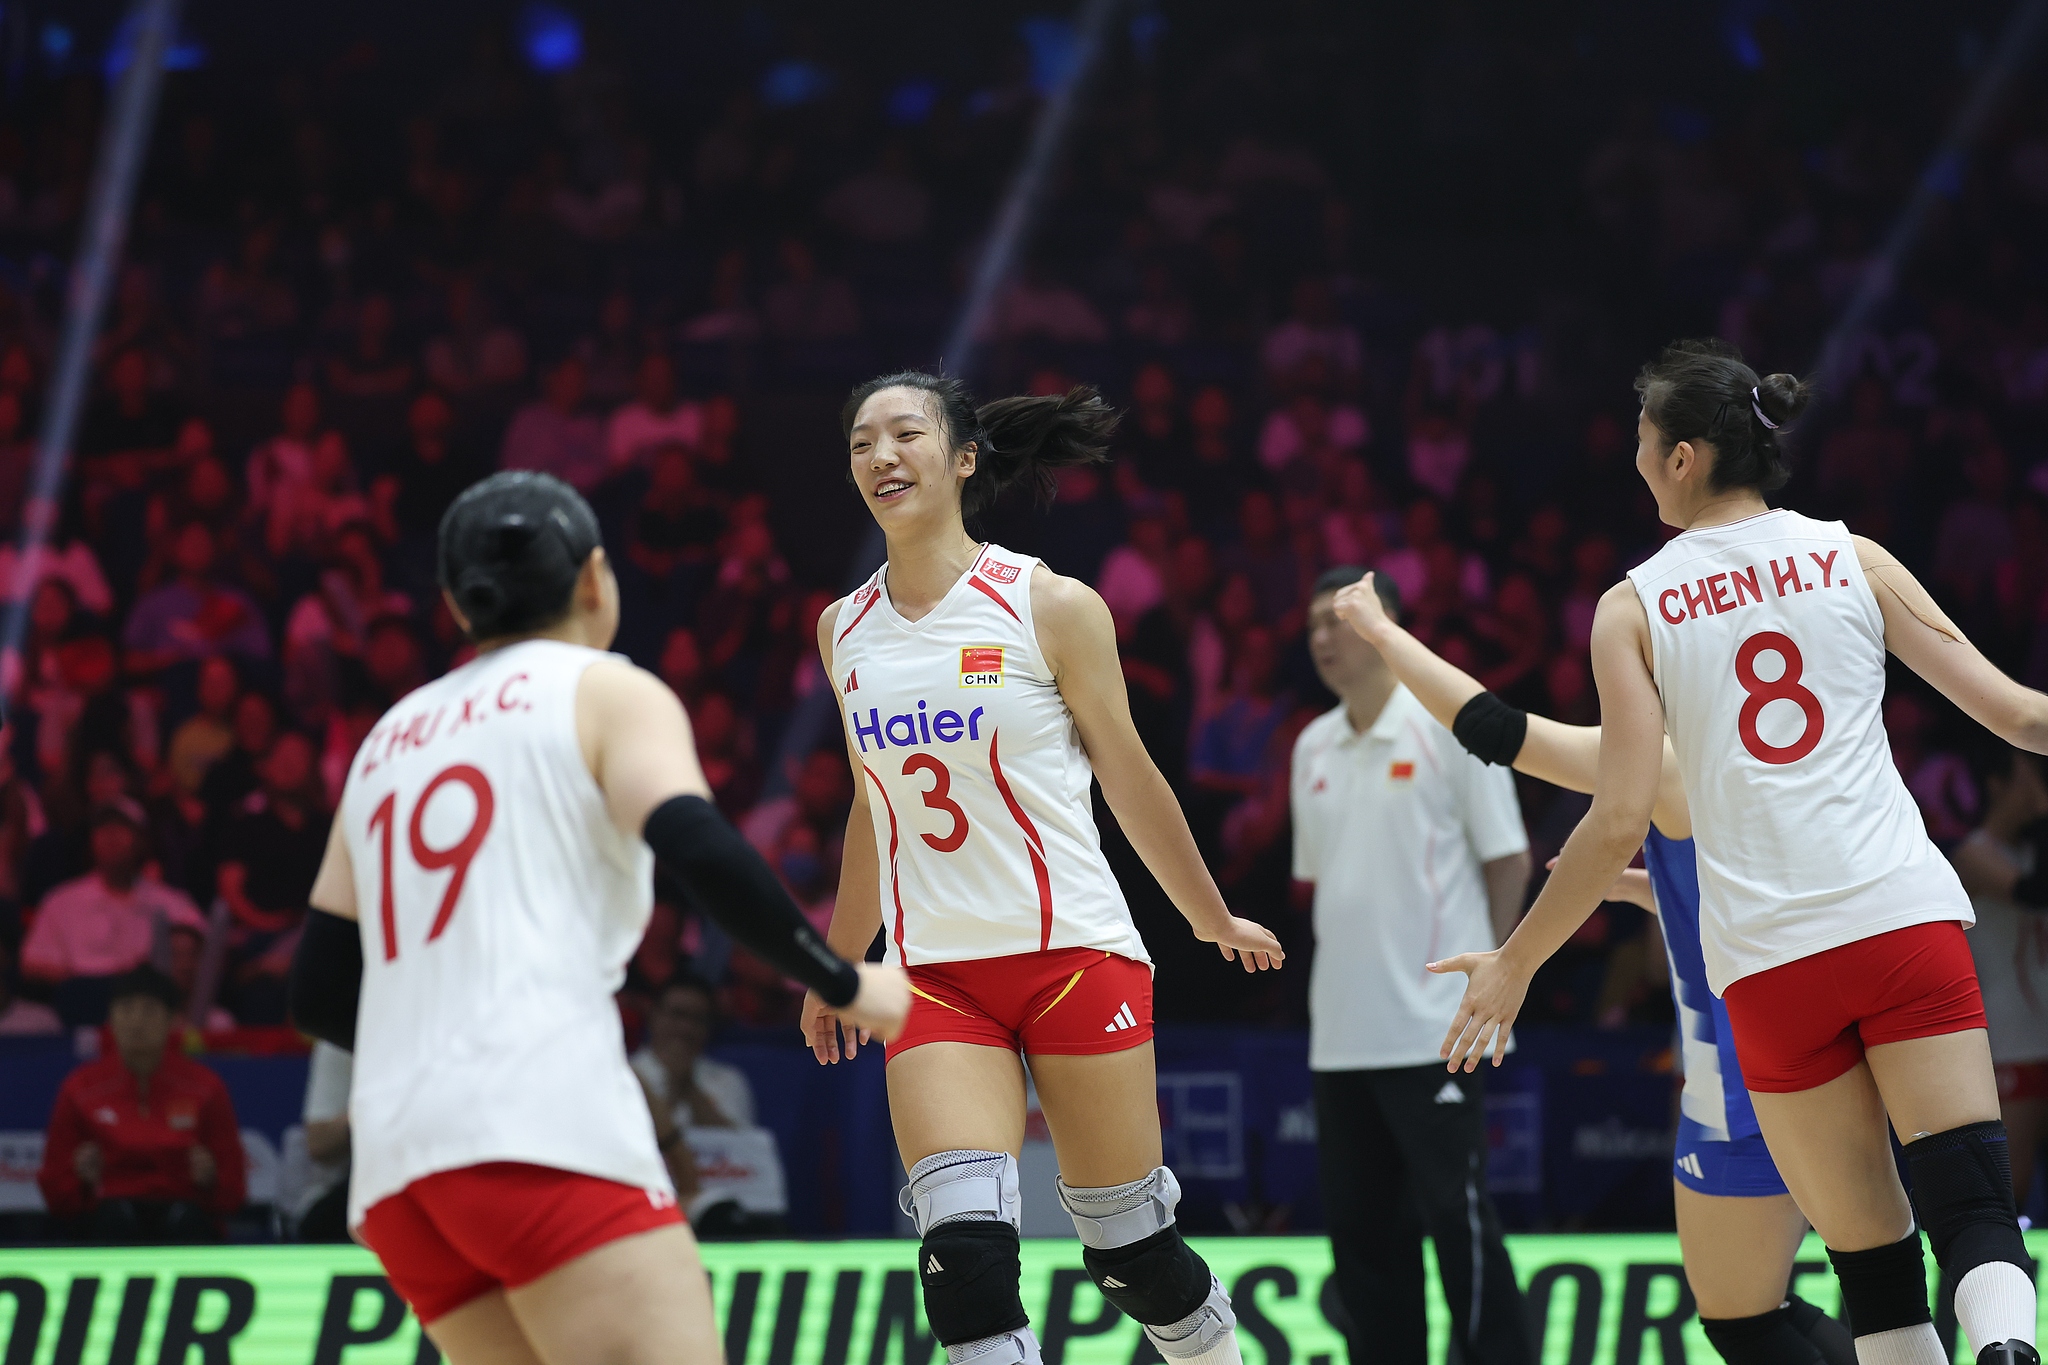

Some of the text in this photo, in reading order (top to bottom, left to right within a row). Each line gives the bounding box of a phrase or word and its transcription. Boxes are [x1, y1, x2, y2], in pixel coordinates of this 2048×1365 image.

[981, 558, 1020, 582] 光明
[1658, 550, 1849, 625] CHEN H.Y.
[964, 674, 998, 685] CHN
[1735, 631, 1825, 765] 8
[852, 699, 985, 753] Haier
[902, 753, 969, 853] 3
[367, 762, 494, 963] 19
